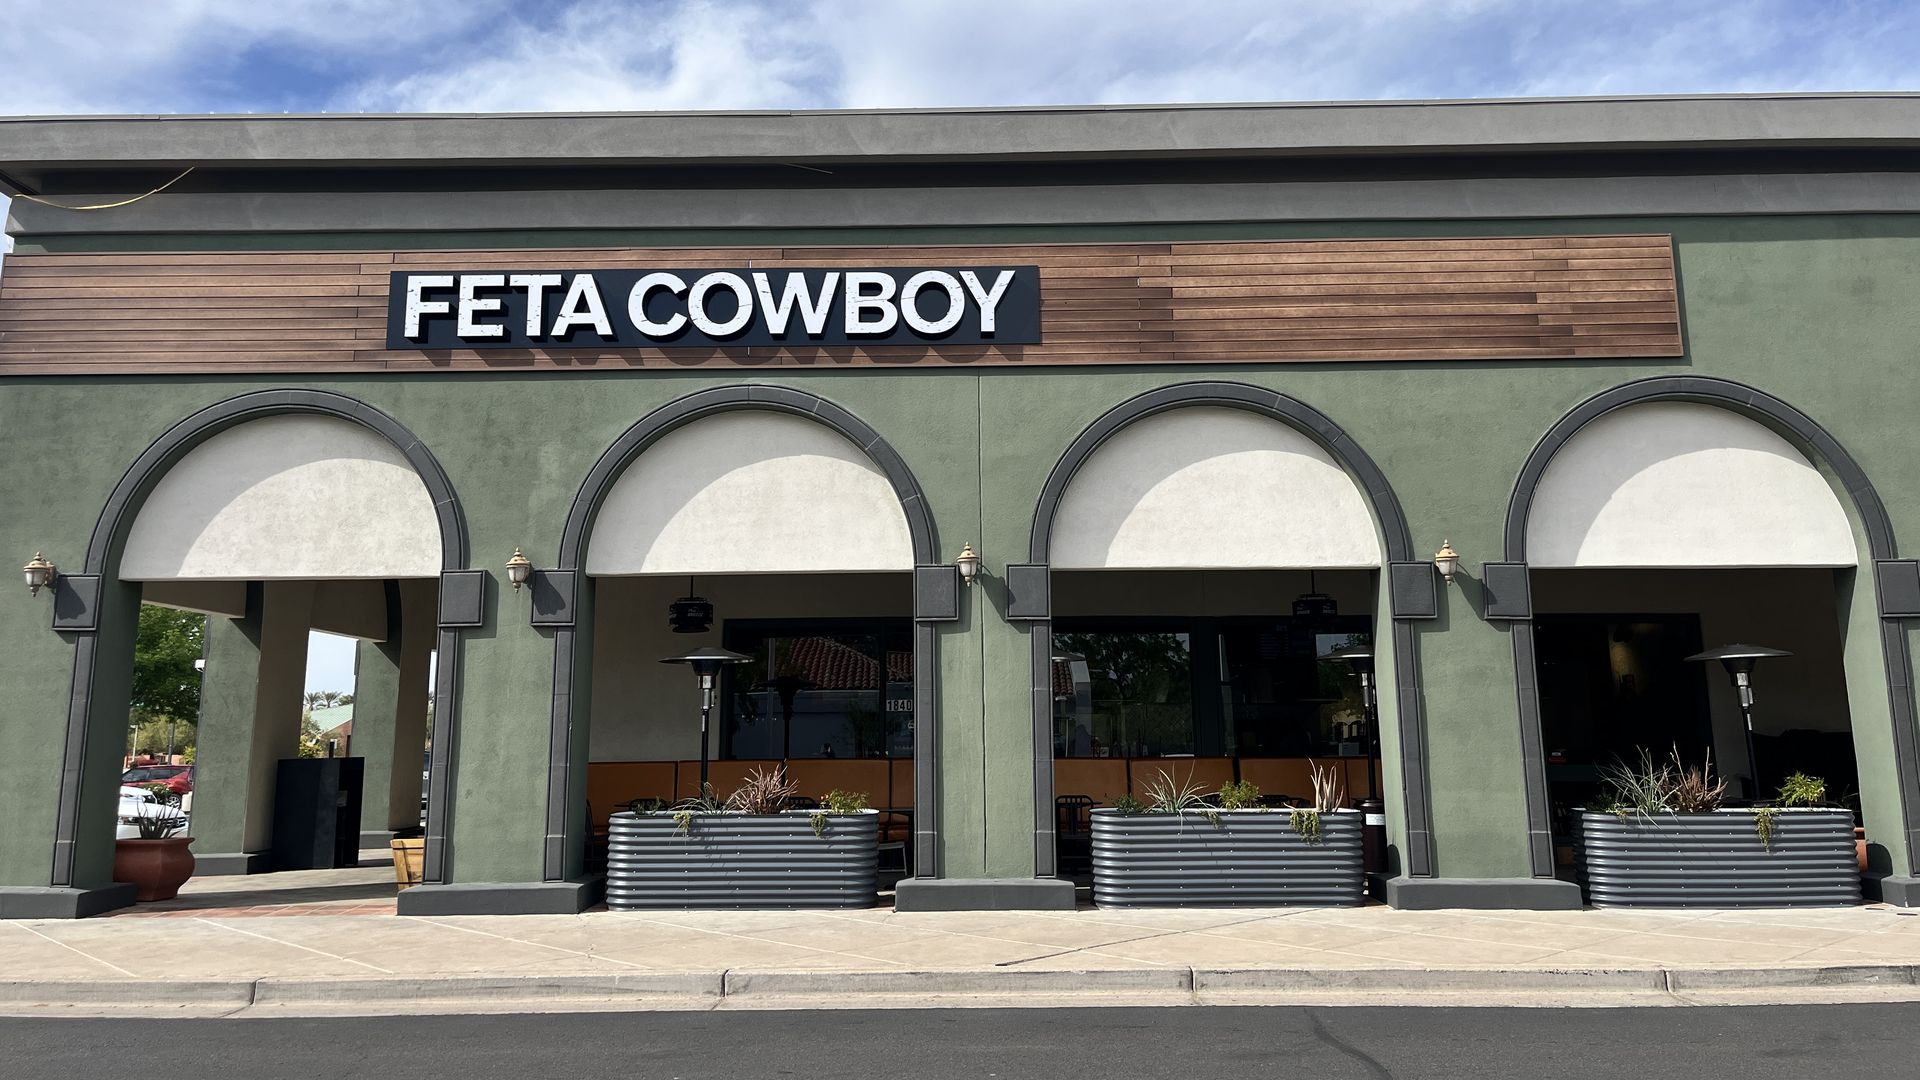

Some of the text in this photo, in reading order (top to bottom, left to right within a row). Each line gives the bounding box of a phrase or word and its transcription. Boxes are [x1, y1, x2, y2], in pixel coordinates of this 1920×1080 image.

[403, 270, 1016, 338] FETA COWBOY
[887, 700, 912, 711] 1840
